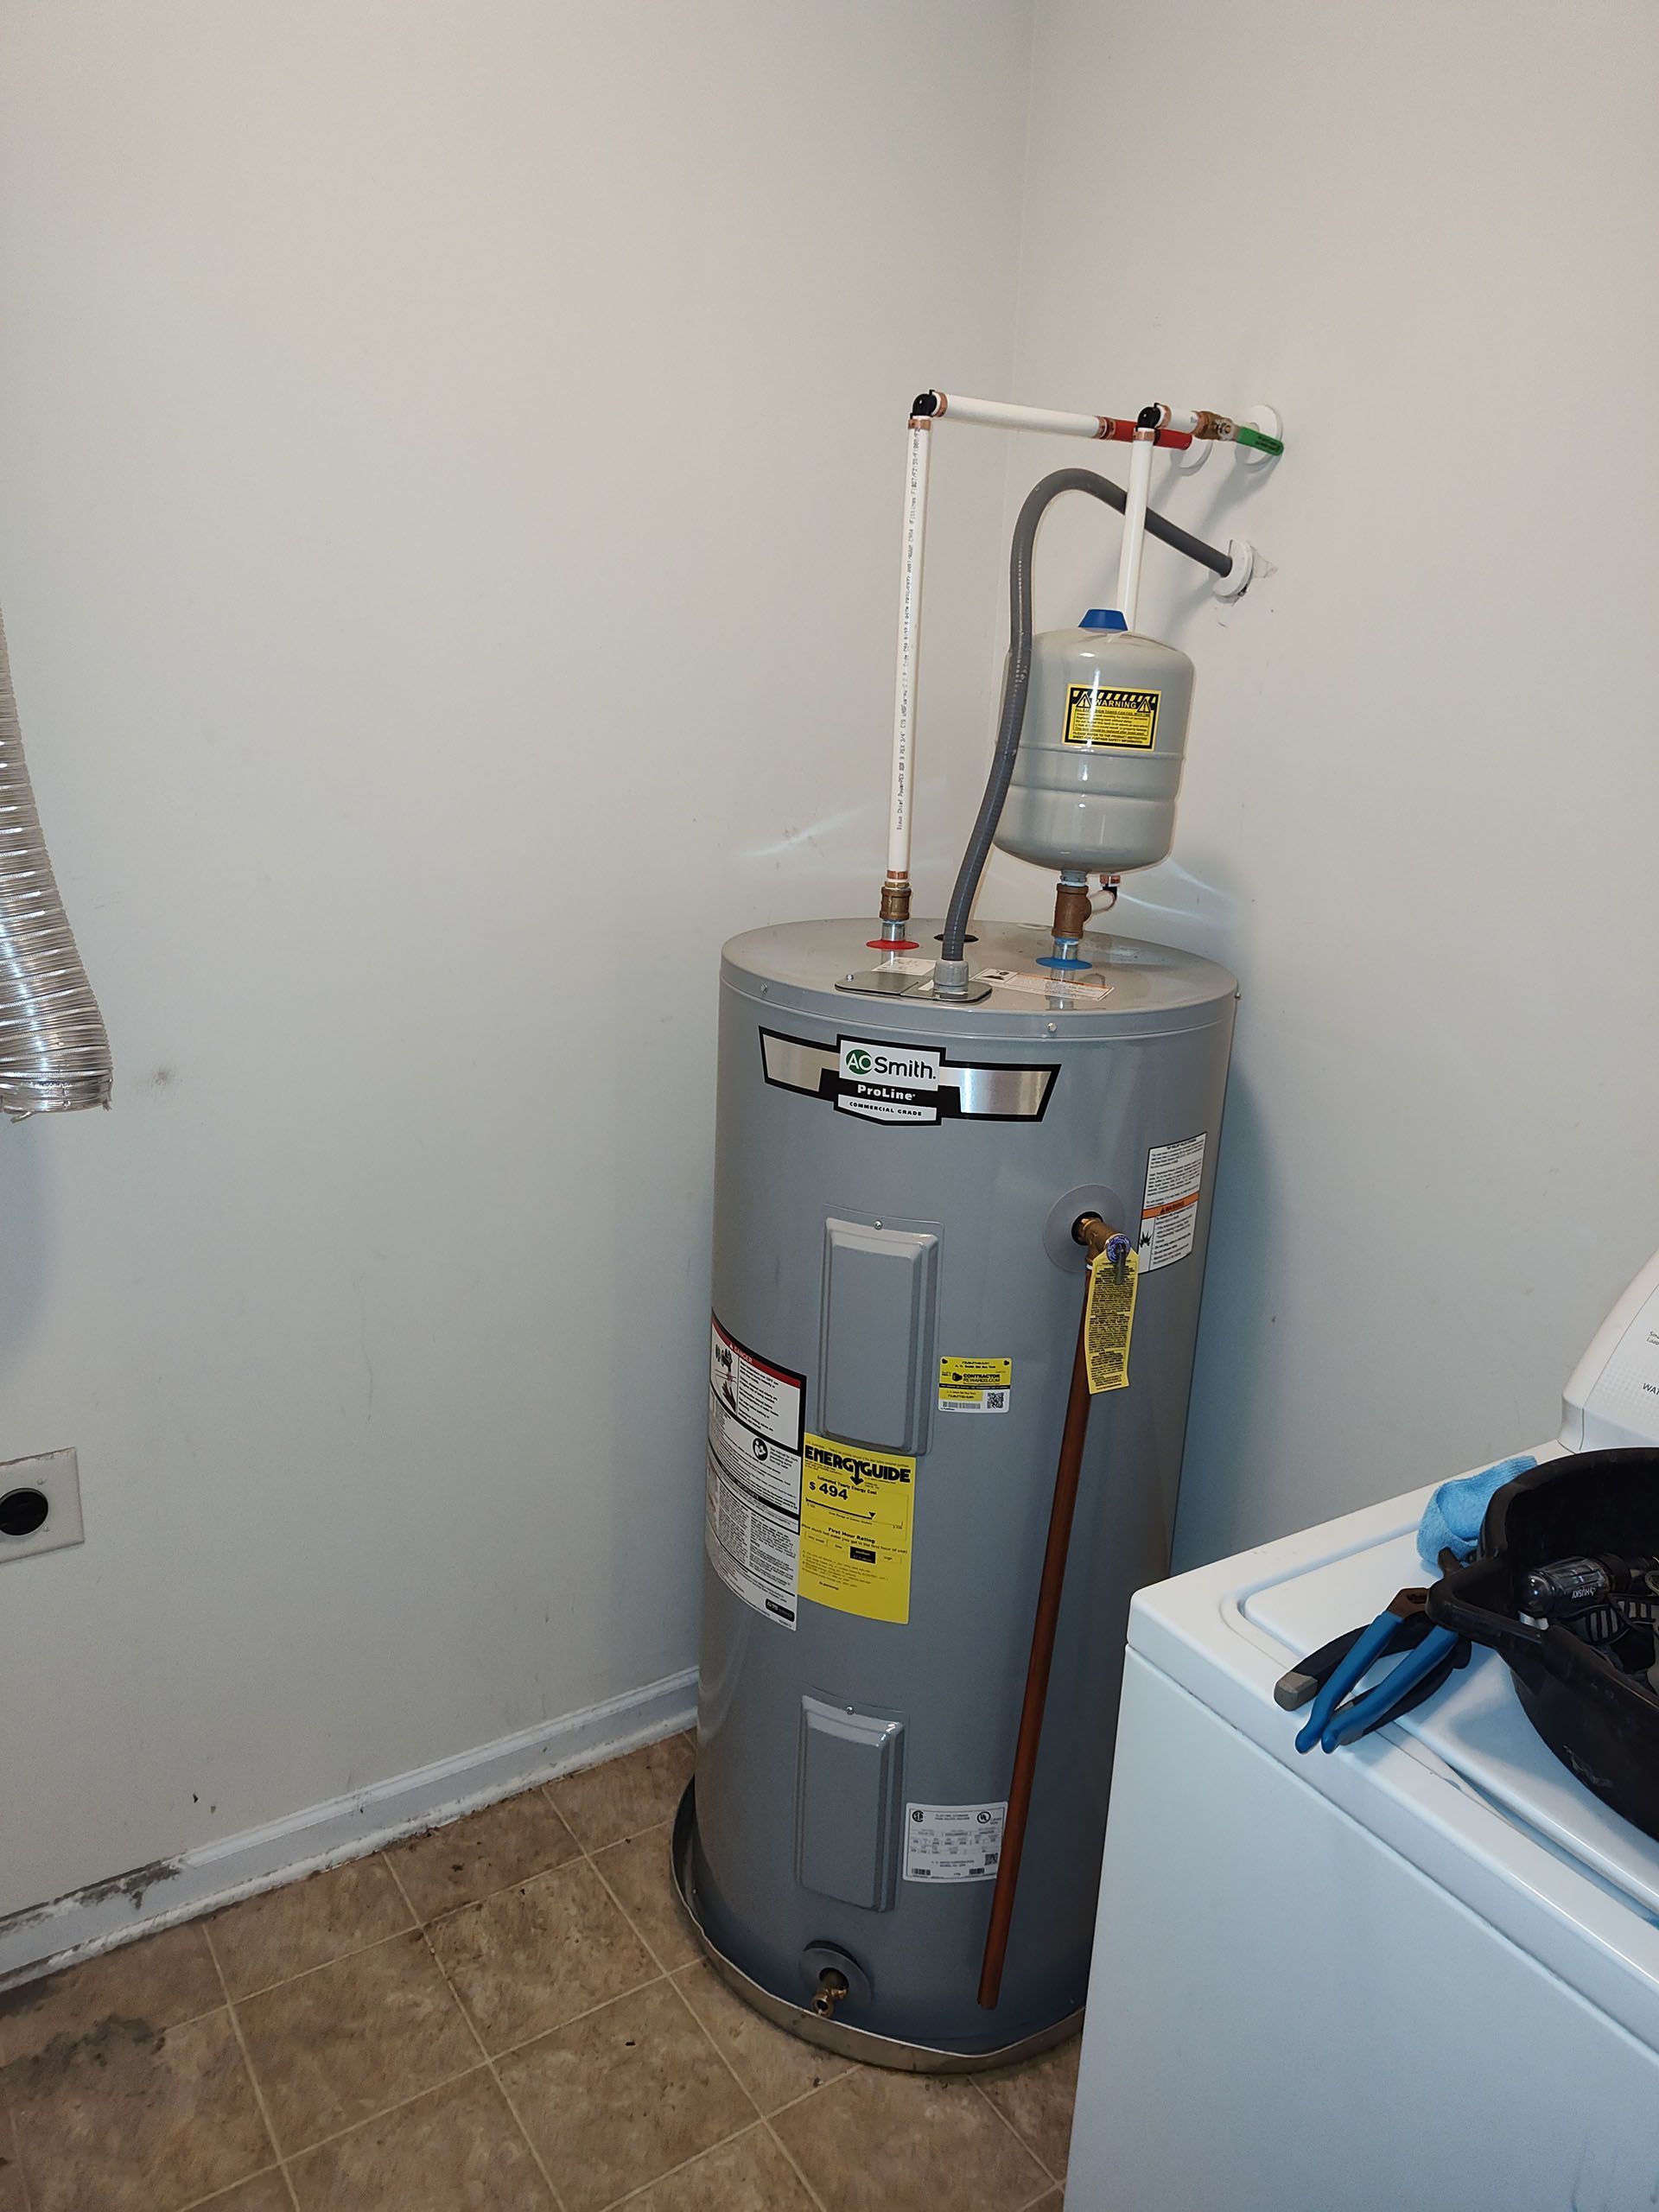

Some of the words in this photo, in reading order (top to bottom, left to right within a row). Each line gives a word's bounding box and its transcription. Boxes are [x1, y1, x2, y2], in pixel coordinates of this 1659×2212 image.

[849, 1102, 894, 1113] COMMERCIAL
[804, 1444, 912, 1484] ENERGYGUIDE
[817, 1475, 837, 1485] Estimated
[851, 1485, 867, 1494] Energy
[818, 1483, 849, 1501] 494
[828, 1527, 841, 1535] First
[855, 1535, 876, 1544] Rating
